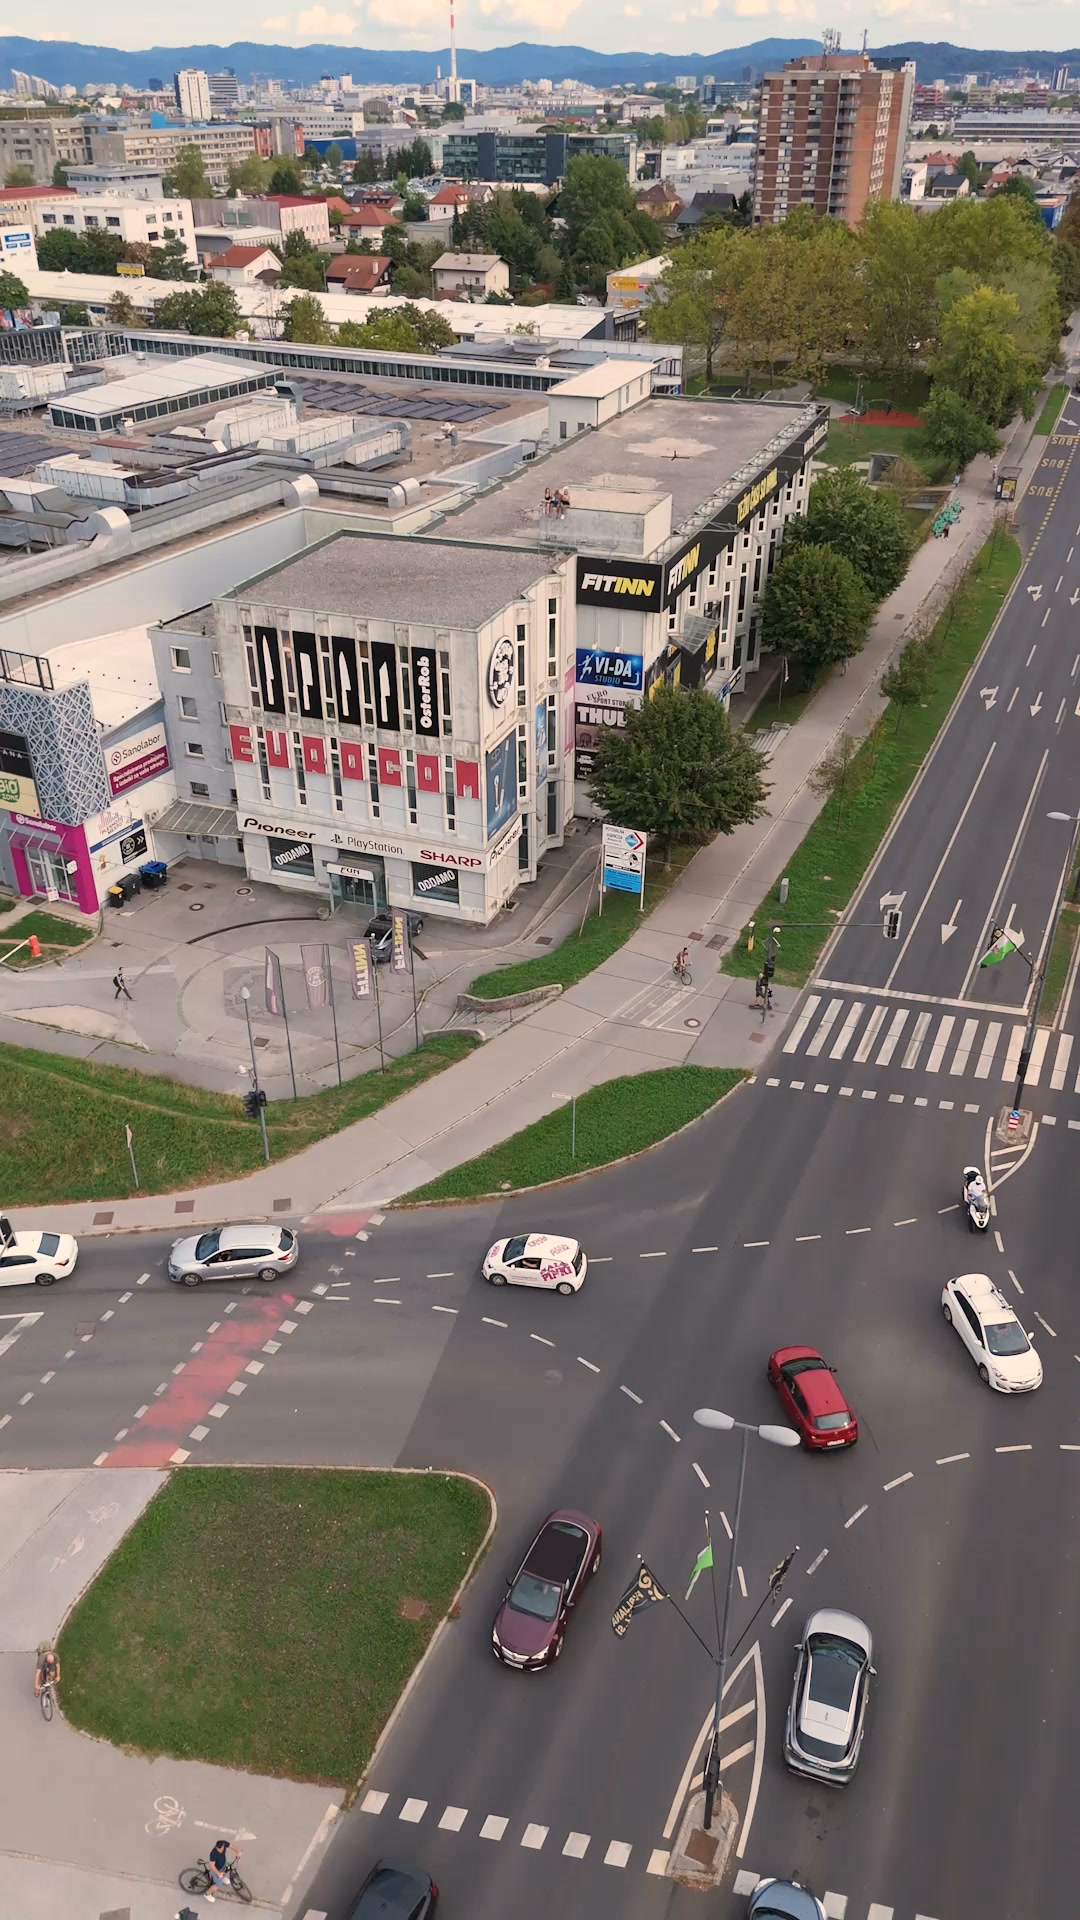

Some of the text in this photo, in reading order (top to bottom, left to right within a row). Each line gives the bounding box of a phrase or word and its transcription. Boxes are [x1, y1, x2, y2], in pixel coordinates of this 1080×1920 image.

[1051, 436, 1073, 446] BUS
[1041, 458, 1065, 469] BUS
[1028, 485, 1054, 497] BUS
[667, 542, 700, 596] FITINN
[581, 572, 655, 597] FITINN
[595, 656, 632, 678] VI-DA
[595, 674, 621, 685] STUDIO
[417, 655, 433, 729] OsterRob
[123, 734, 161, 759] Sanolabor
[229, 724, 480, 800] EUROCOM
[24, 815, 57, 832] Sanolabor
[243, 818, 316, 840] Pioneer
[274, 843, 311, 866] ODDAMO
[347, 836, 403, 856] PlayStation
[489, 825, 520, 866] Pioneer
[420, 849, 482, 868] SHARP
[417, 869, 456, 892] ODDAMO
